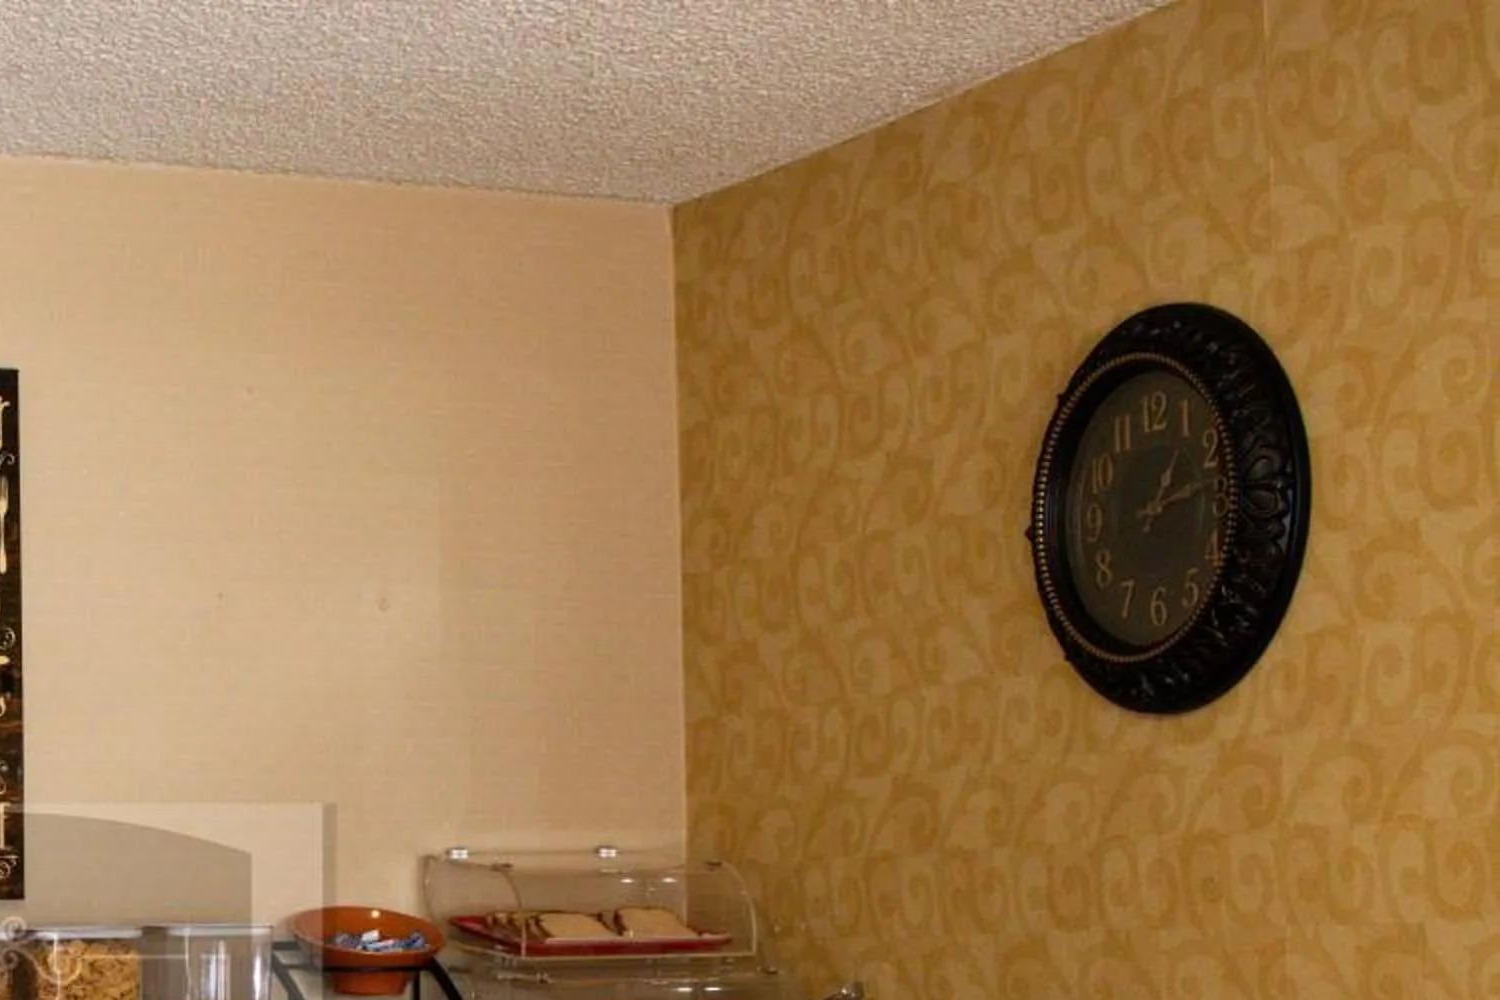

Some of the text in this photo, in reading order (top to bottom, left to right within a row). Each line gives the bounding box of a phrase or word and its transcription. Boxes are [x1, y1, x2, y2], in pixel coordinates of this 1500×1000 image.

[1142, 390, 1167, 432] 12
[1179, 398, 1192, 437] 1
[1113, 414, 1131, 451] 11
[1202, 429, 1219, 469] 2
[1088, 456, 1114, 494] 10
[1211, 477, 1229, 517] 3
[1086, 506, 1102, 543] 9
[1205, 530, 1223, 568] 4
[1095, 552, 1113, 589] 8
[1181, 568, 1198, 607] 5
[1120, 580, 1135, 619] 7
[1150, 587, 1167, 626] 6
